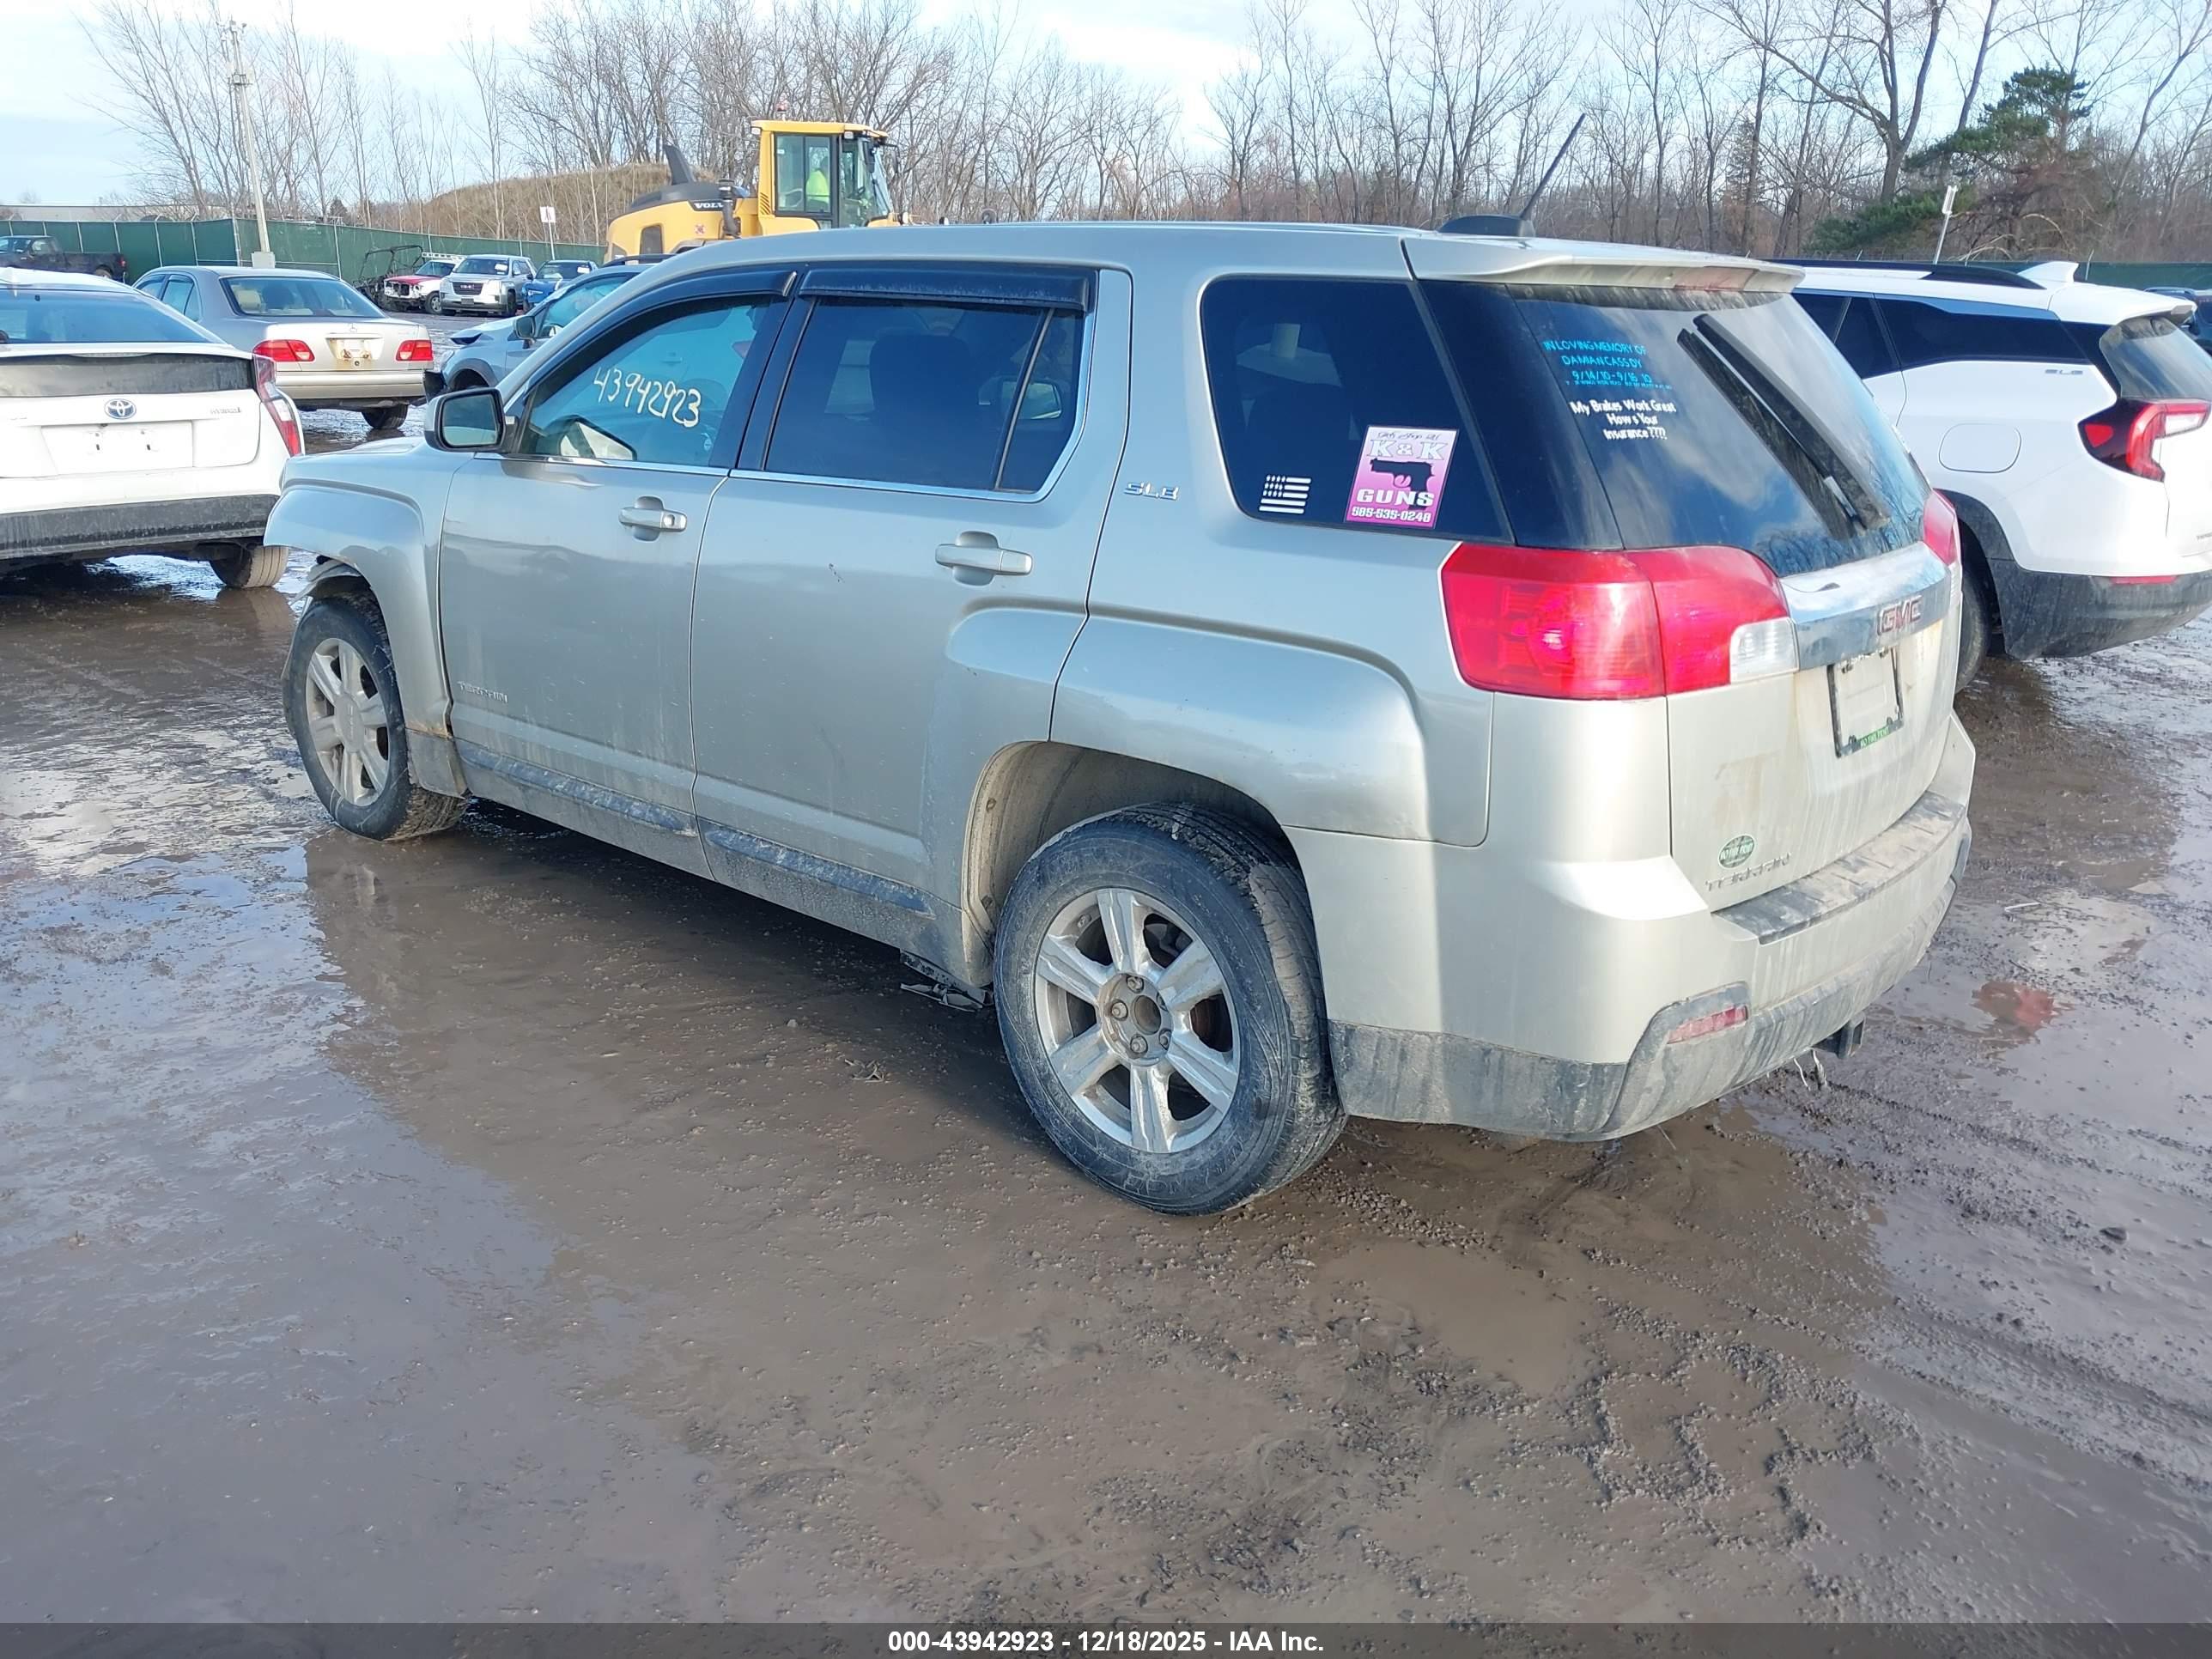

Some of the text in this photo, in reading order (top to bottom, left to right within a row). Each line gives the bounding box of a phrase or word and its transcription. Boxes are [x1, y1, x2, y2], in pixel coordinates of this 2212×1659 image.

[593, 367, 702, 428] 43942923
[1569, 398, 1677, 416] My Brakes Work Great
[1637, 412, 1658, 425] Your
[1367, 439, 1449, 460] K & K
[1356, 488, 1436, 507] GUNS
[1877, 595, 1923, 635] GMC
